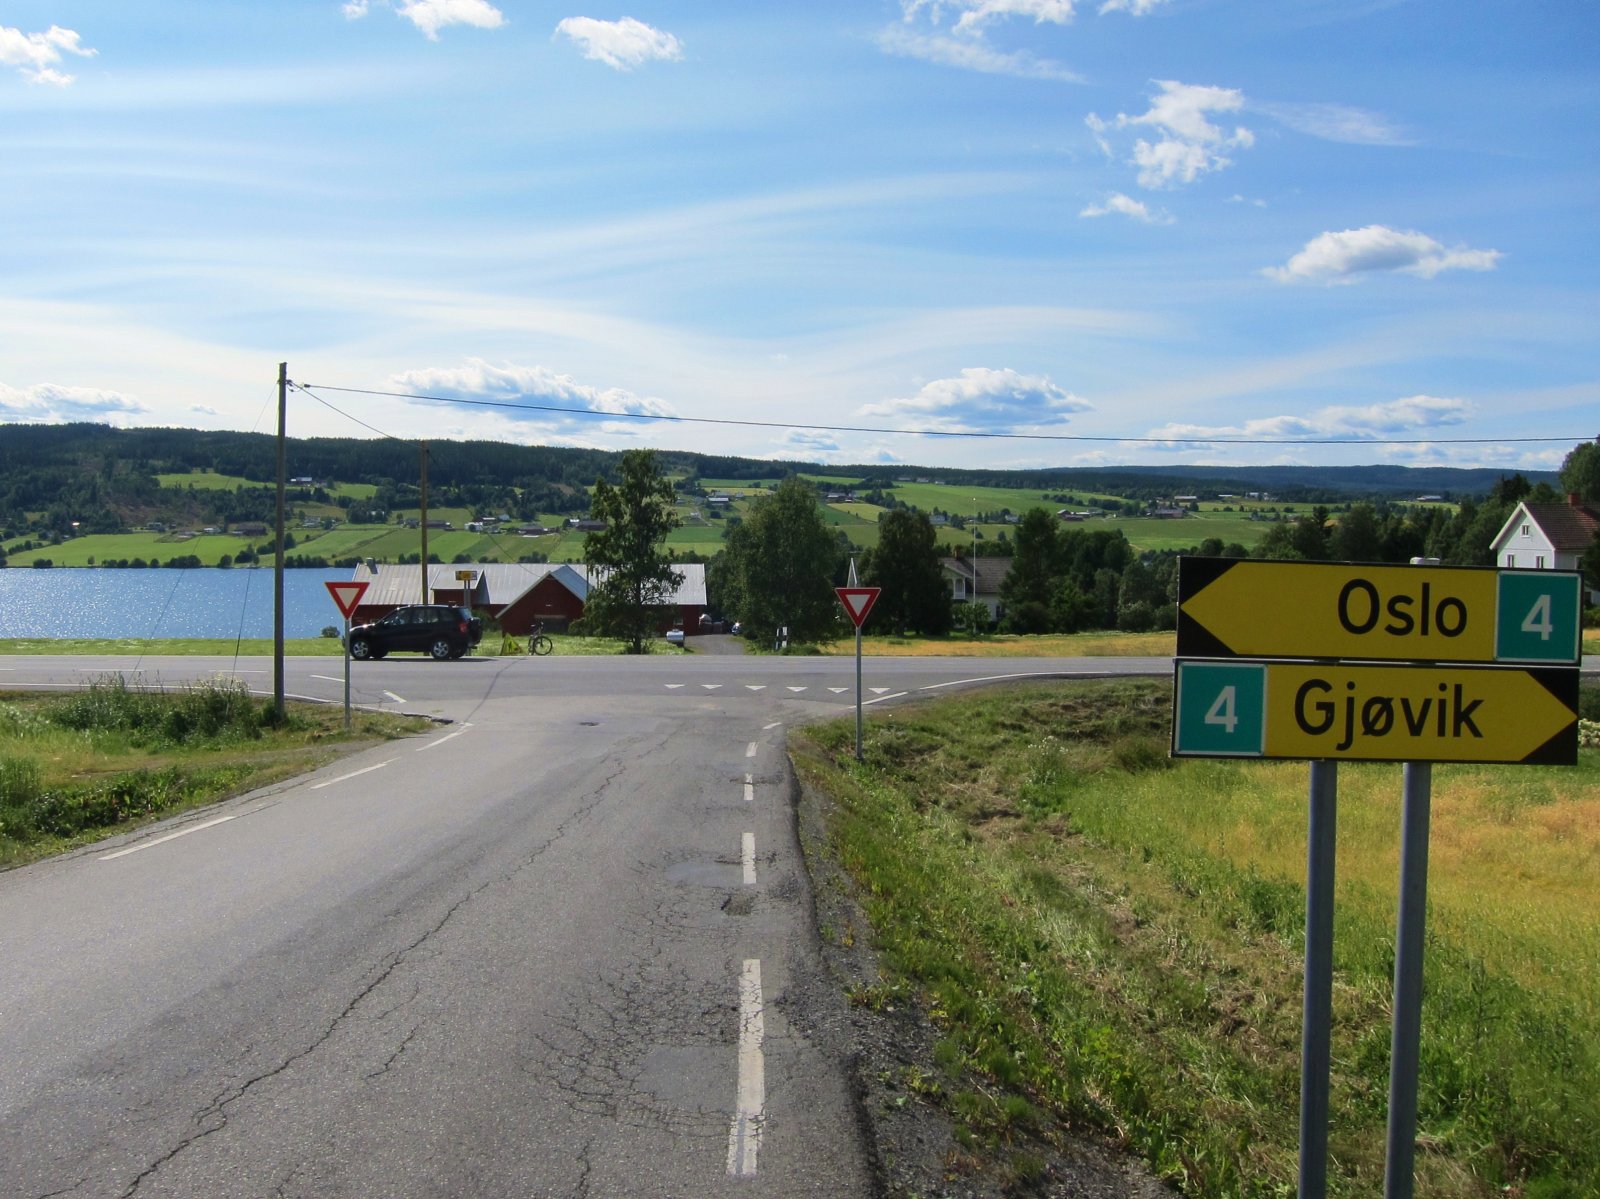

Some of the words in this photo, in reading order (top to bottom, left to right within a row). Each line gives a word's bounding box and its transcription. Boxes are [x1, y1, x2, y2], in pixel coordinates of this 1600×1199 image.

[1337, 578, 1467, 637] Oslo
[1521, 594, 1553, 641] 4
[1204, 685, 1238, 733] 4
[1294, 678, 1484, 751] Gjøvik
